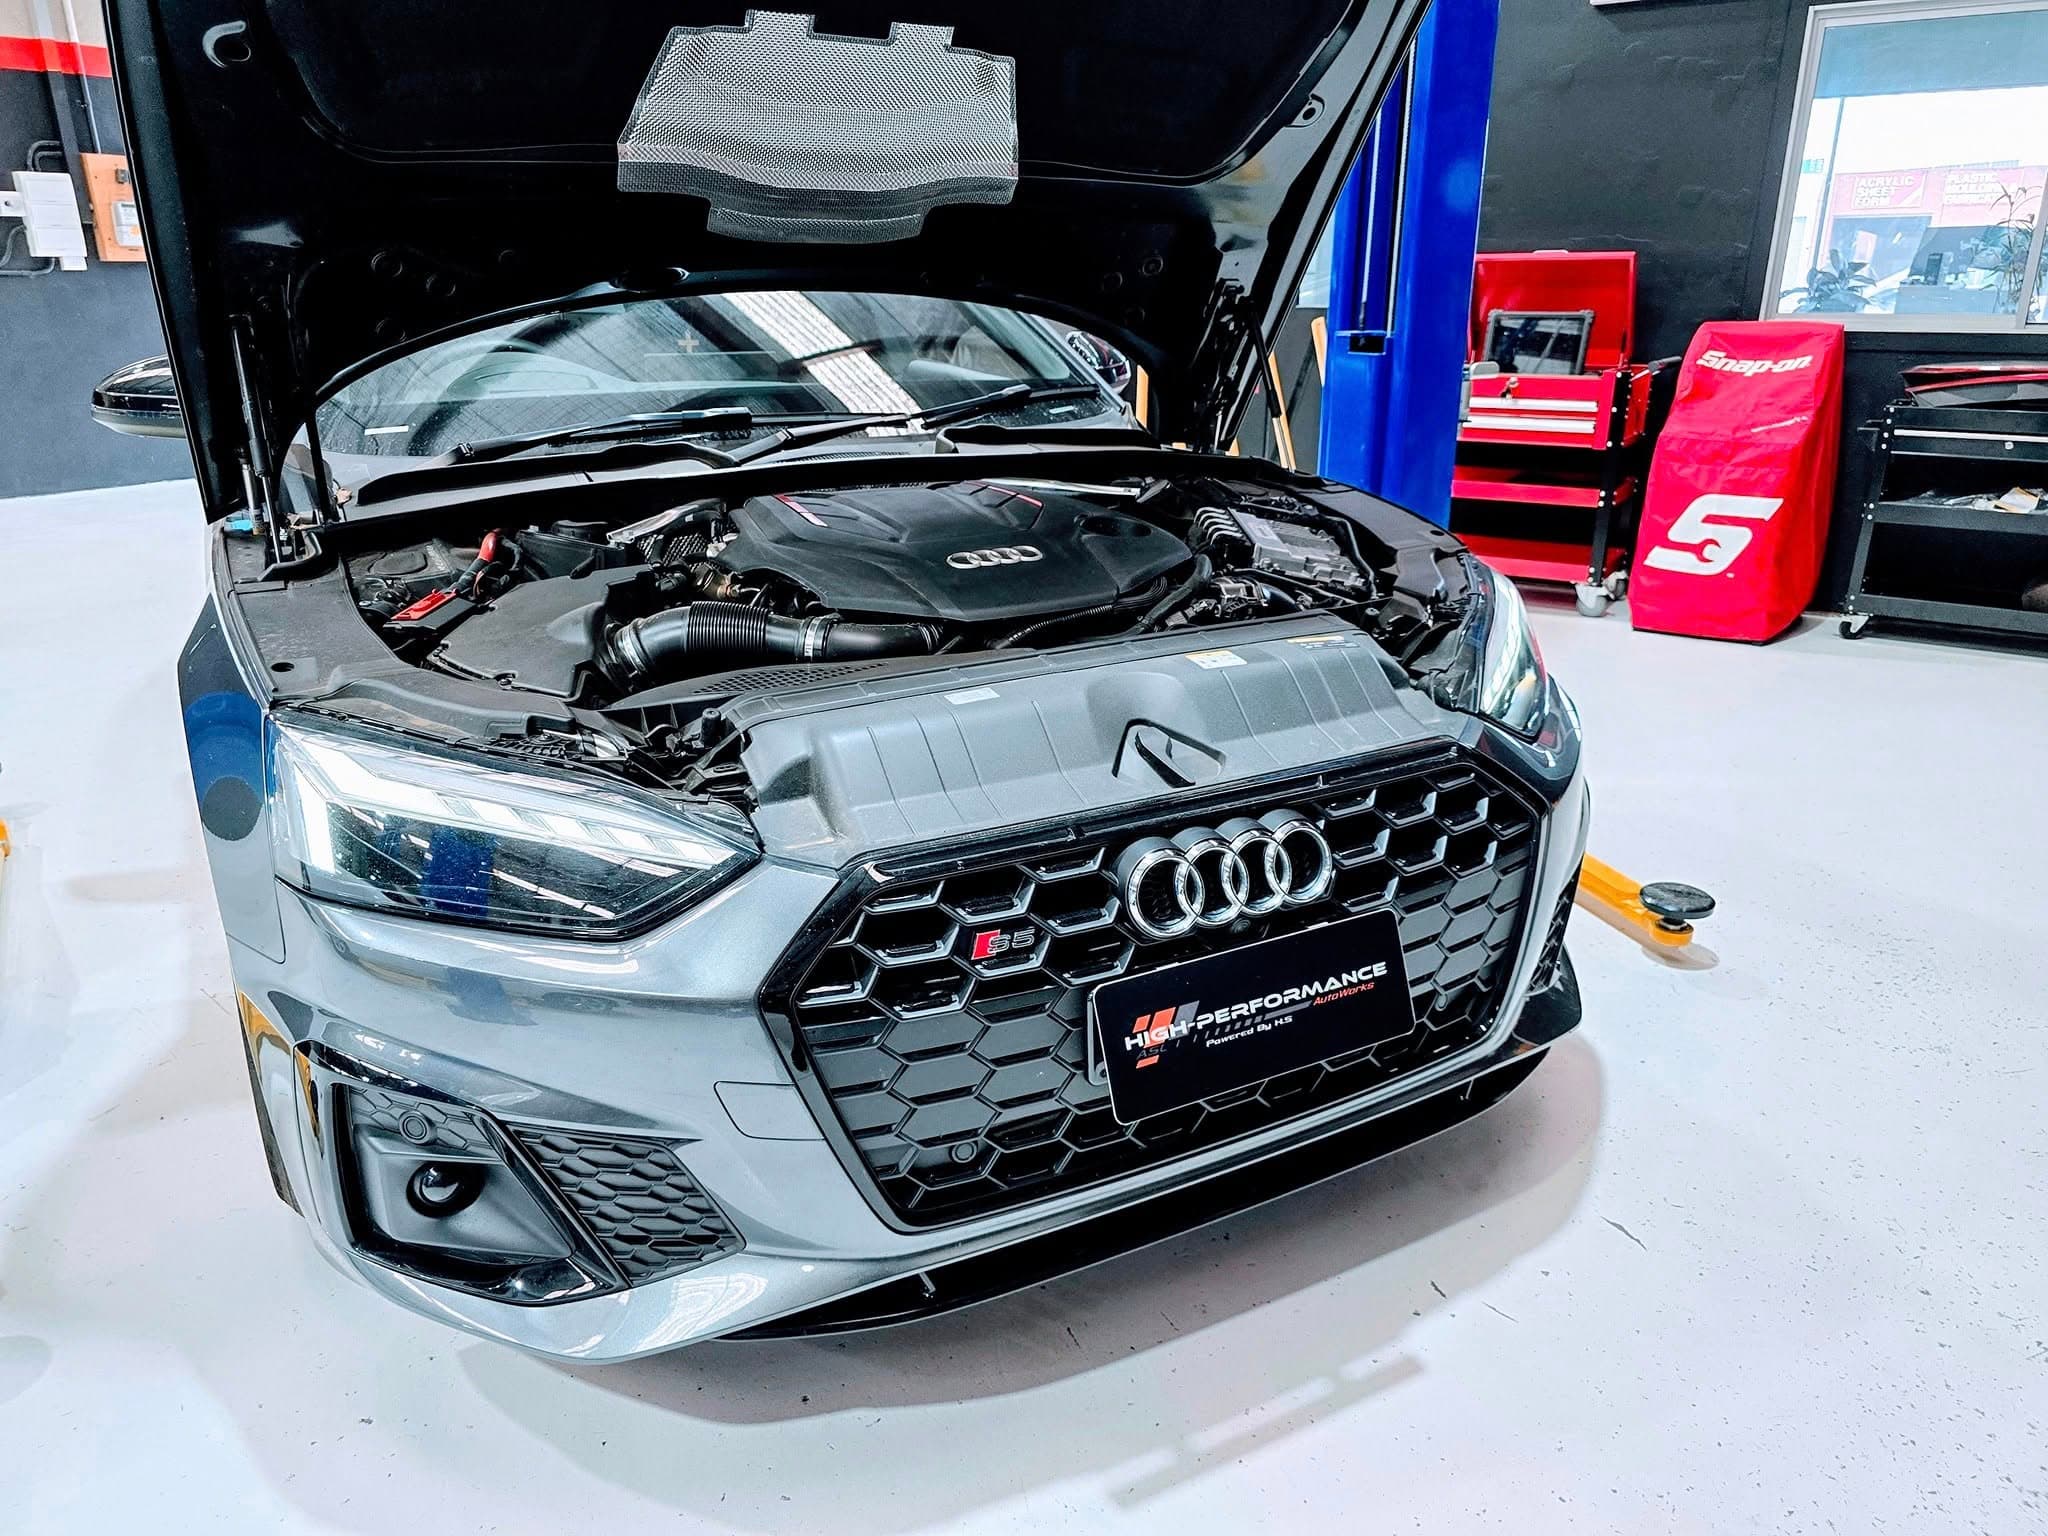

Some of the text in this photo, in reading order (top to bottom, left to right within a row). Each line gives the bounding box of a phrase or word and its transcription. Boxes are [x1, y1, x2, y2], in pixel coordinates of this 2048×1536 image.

[1858, 175, 1915, 187] ACRYLIC
[1696, 349, 1813, 377] Snap-on
[987, 926, 1036, 955] S5
[1124, 961, 1388, 1051] HIGH-PERFORMANCE
[1313, 981, 1376, 1007] AutoWorks
[1206, 1027, 1254, 1048] Powered
[1256, 1021, 1272, 1032] By
